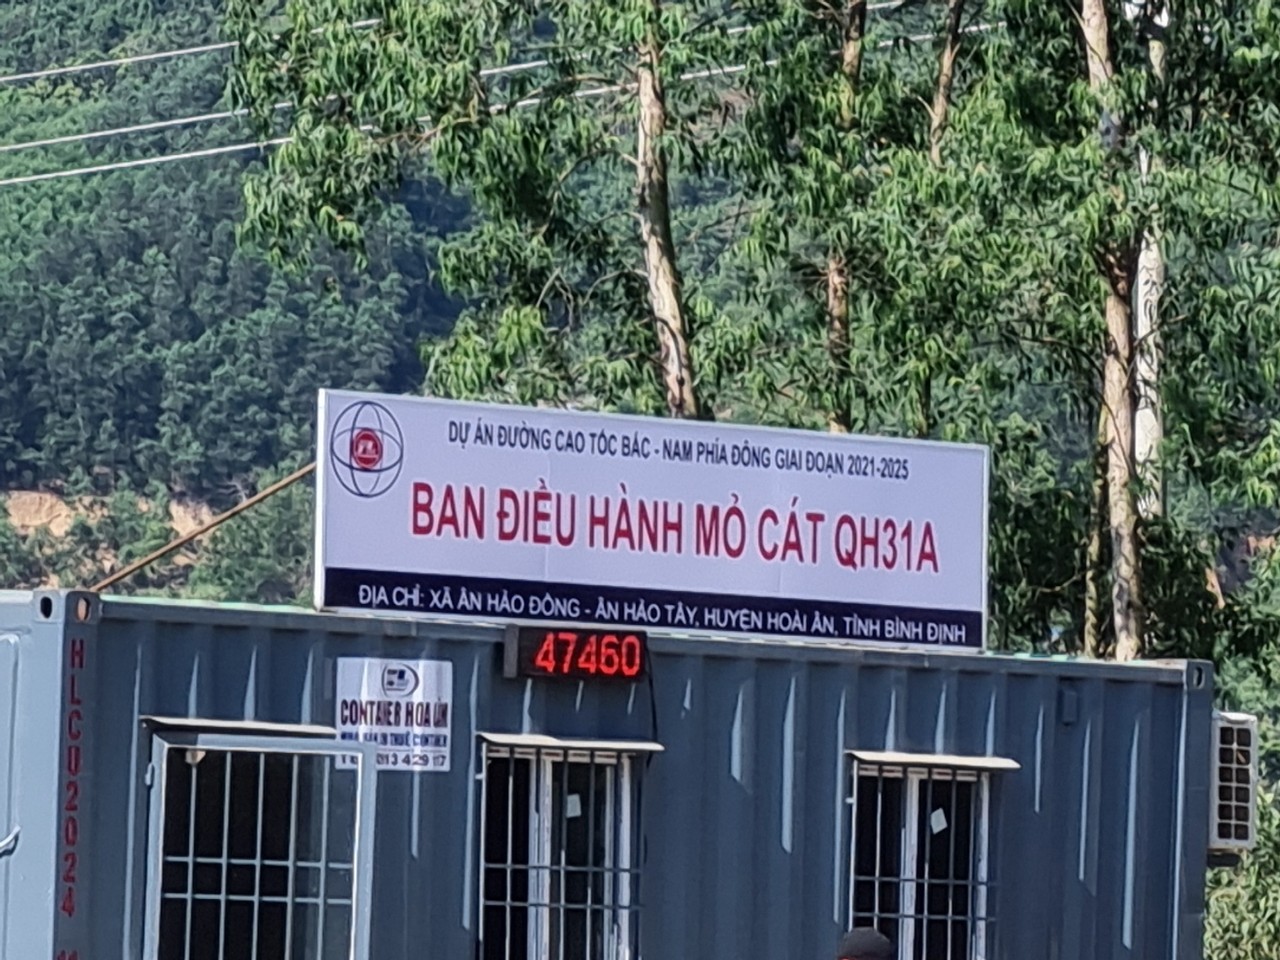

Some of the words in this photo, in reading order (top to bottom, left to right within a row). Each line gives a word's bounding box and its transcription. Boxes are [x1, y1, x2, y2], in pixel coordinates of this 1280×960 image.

[449, 420, 471, 449] DỰ
[474, 417, 493, 446] ÁN
[498, 421, 550, 451] ĐƯỜNG
[555, 429, 586, 453] CAO
[662, 438, 693, 461] NAM
[697, 437, 728, 465] PHÍA
[732, 439, 771, 469] ĐÔNG
[775, 448, 802, 470] GIAI
[805, 451, 844, 478] ĐOẠN
[848, 455, 909, 480] 2021-2025
[412, 482, 485, 540] BAN
[497, 478, 575, 547] ĐIỀU
[589, 483, 683, 555] HÀNH
[695, 493, 746, 559] MỎ
[758, 496, 825, 564] CÁT
[835, 514, 939, 573] QH31A
[358, 584, 389, 609] ĐỊA
[392, 583, 425, 607] CHỈ:
[429, 586, 453, 609] XÃ
[487, 589, 524, 613] HẢO
[528, 593, 580, 618] ĐÔNG
[665, 601, 700, 627] TÂY,
[704, 607, 762, 631] HUYỆN
[767, 609, 807, 632] HOÀI
[843, 613, 880, 637] TỈNH
[884, 616, 923, 640] BÌNH
[926, 622, 966, 645] ĐỊNH
[535, 631, 640, 676] 47460
[341, 699, 401, 727] CONTAER
